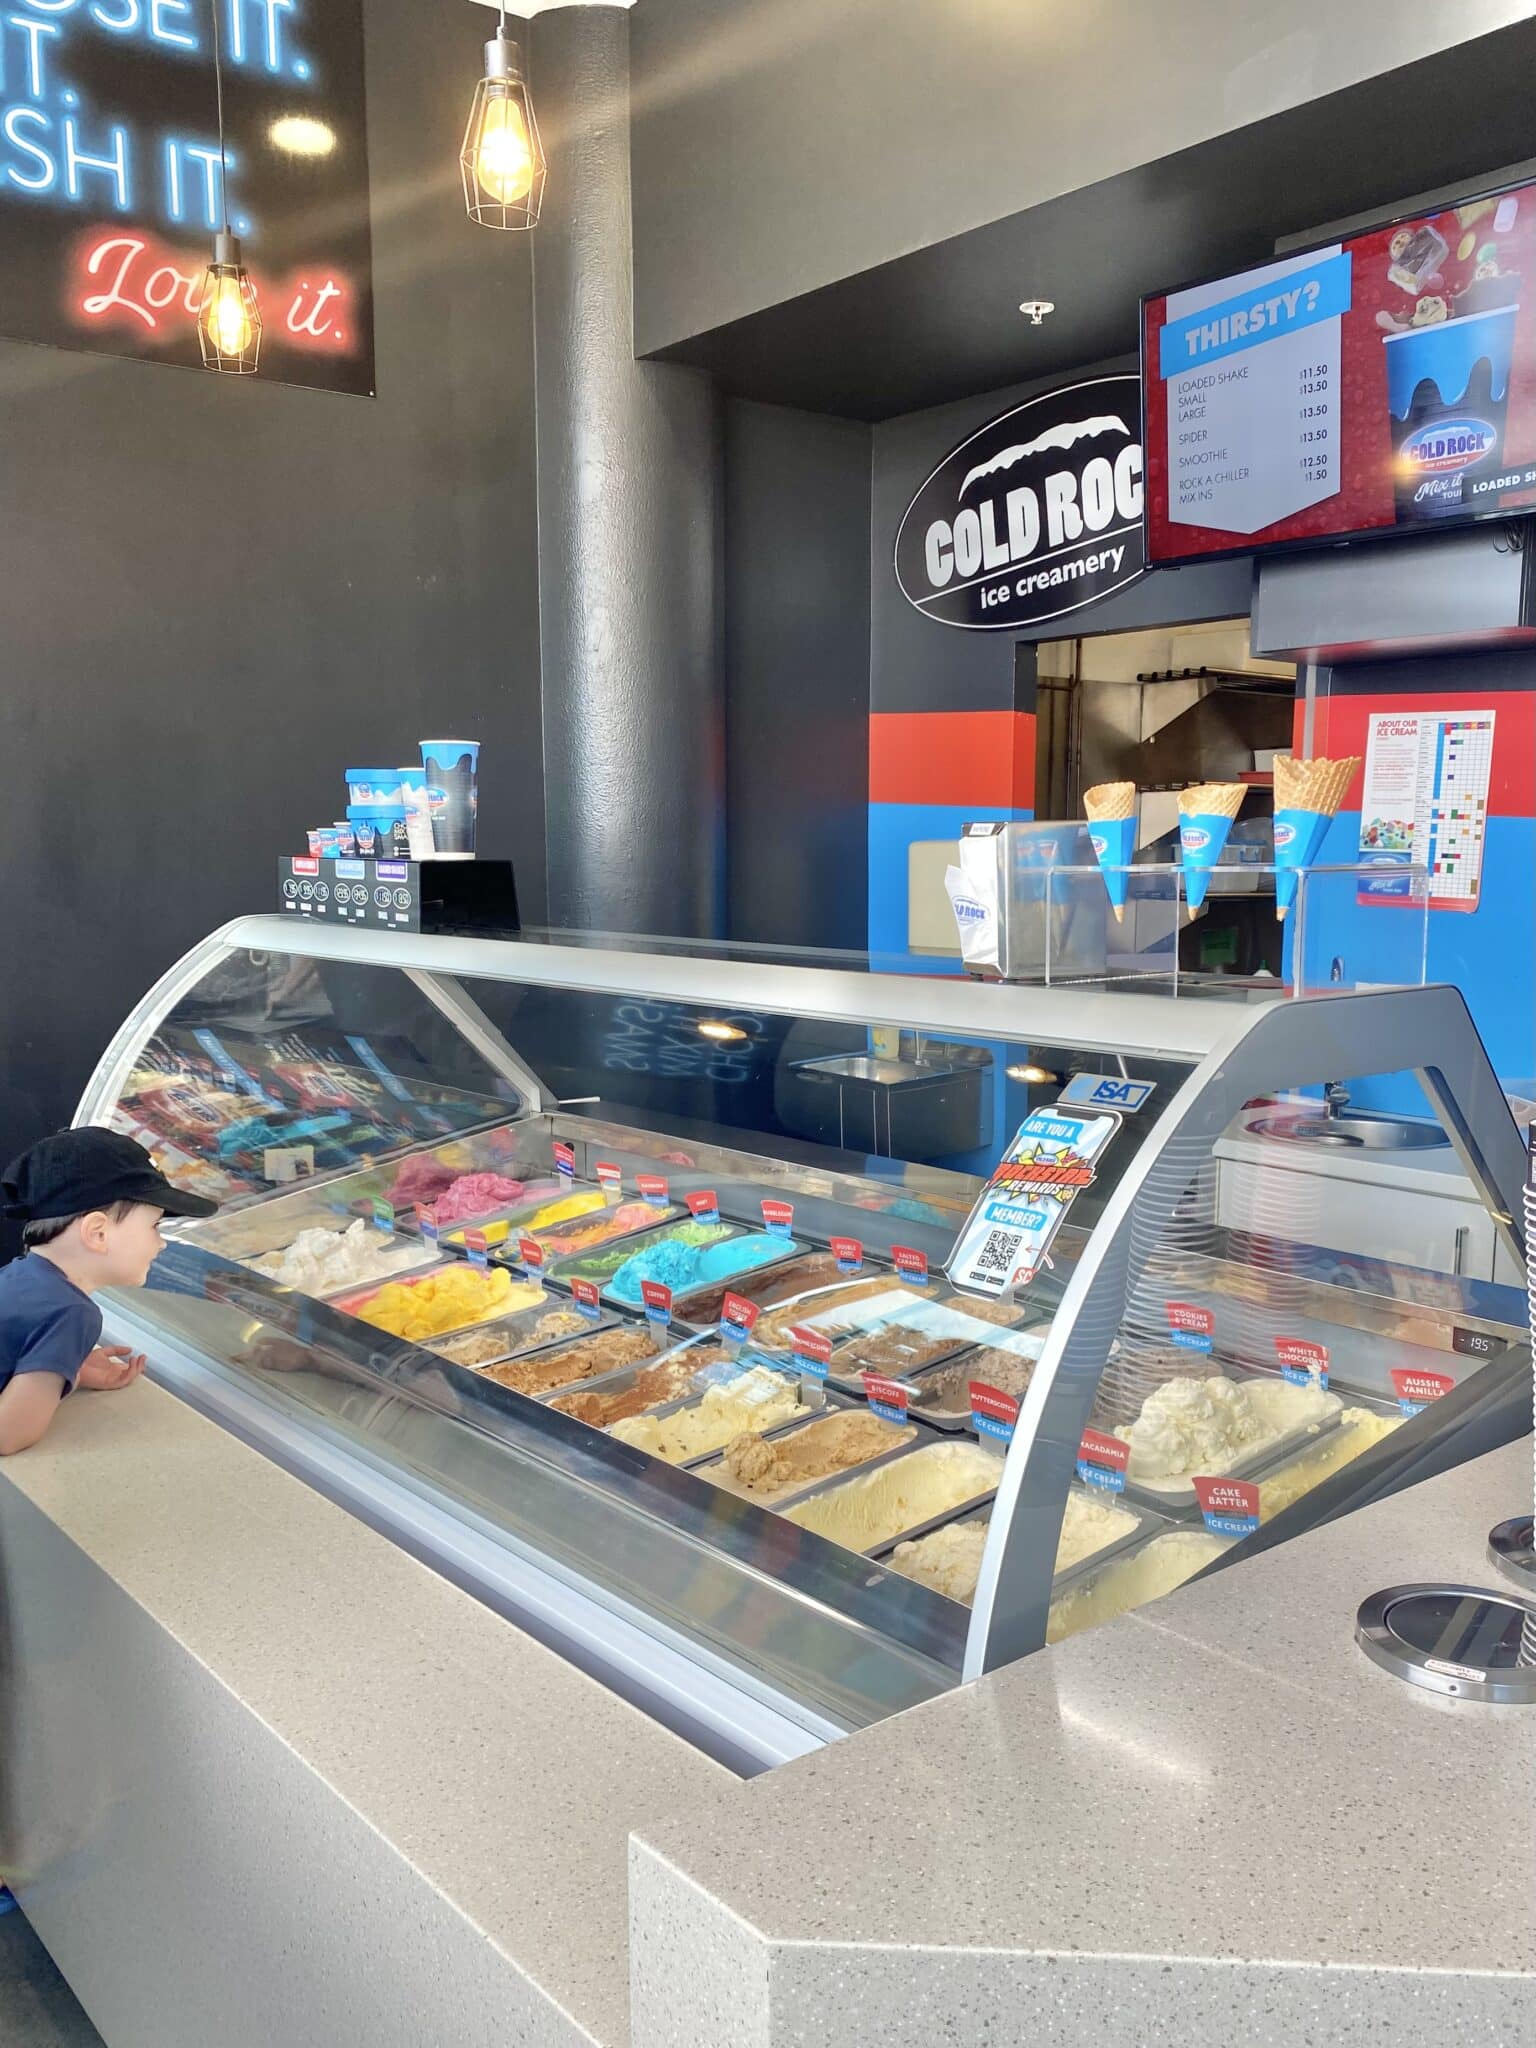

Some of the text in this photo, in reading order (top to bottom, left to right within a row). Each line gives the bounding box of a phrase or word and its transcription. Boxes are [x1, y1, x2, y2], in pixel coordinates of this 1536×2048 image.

[2, 106, 249, 231] SH IT.
[286, 279, 343, 340] it.
[1184, 280, 1321, 357] THIRSTY?
[1178, 366, 1249, 394] LOADED SHAKE
[1178, 392, 1207, 408] SMALL
[1178, 406, 1207, 423] LARGE
[1178, 429, 1208, 445] SPIDER
[1410, 431, 1486, 460] COLD ROCK
[1178, 448, 1229, 468] SMOOTHIE
[1178, 467, 1251, 492] ROCK A CHILLER
[1472, 475, 1521, 495] LOADED
[1179, 488, 1214, 505] MIX INS
[1414, 478, 1450, 503] Mix
[1443, 489, 1463, 500] YOU
[925, 443, 1145, 588] COLD ROC
[980, 545, 1125, 609] ice creamery
[1377, 720, 1402, 728] ABOUT
[1402, 720, 1418, 728] OUR
[1376, 728, 1418, 737] ICE CREAM
[1093, 1080, 1131, 1102] ISA
[1027, 1120, 1076, 1138] ARE YOU A
[1008, 1179, 1063, 1194] REWARDS
[990, 1204, 1042, 1227] MEMBER?
[896, 1258, 923, 1268] CARAMEL
[898, 1252, 920, 1261] SALTED
[646, 1290, 666, 1300] COFFEE
[728, 1300, 752, 1315] ENGLISH
[1174, 1309, 1208, 1323] COOKIES
[1181, 1317, 1209, 1330] CREAM
[1188, 1335, 1211, 1348] CREAM
[1287, 1345, 1318, 1358] WHITE
[1284, 1370, 1298, 1380] ICE
[1406, 1377, 1441, 1388] AUSSIE
[871, 1385, 900, 1398] BISCOFF
[1402, 1385, 1445, 1397] VANILLA
[971, 1392, 1016, 1413] BUTTERSCOTCH
[975, 1417, 1012, 1437] ICE CREAM
[1094, 1473, 1122, 1487] CREAM
[1212, 1487, 1241, 1498] CAKE
[1208, 1495, 1249, 1508] BATTER
[1207, 1518, 1257, 1533] ICE CREAM
